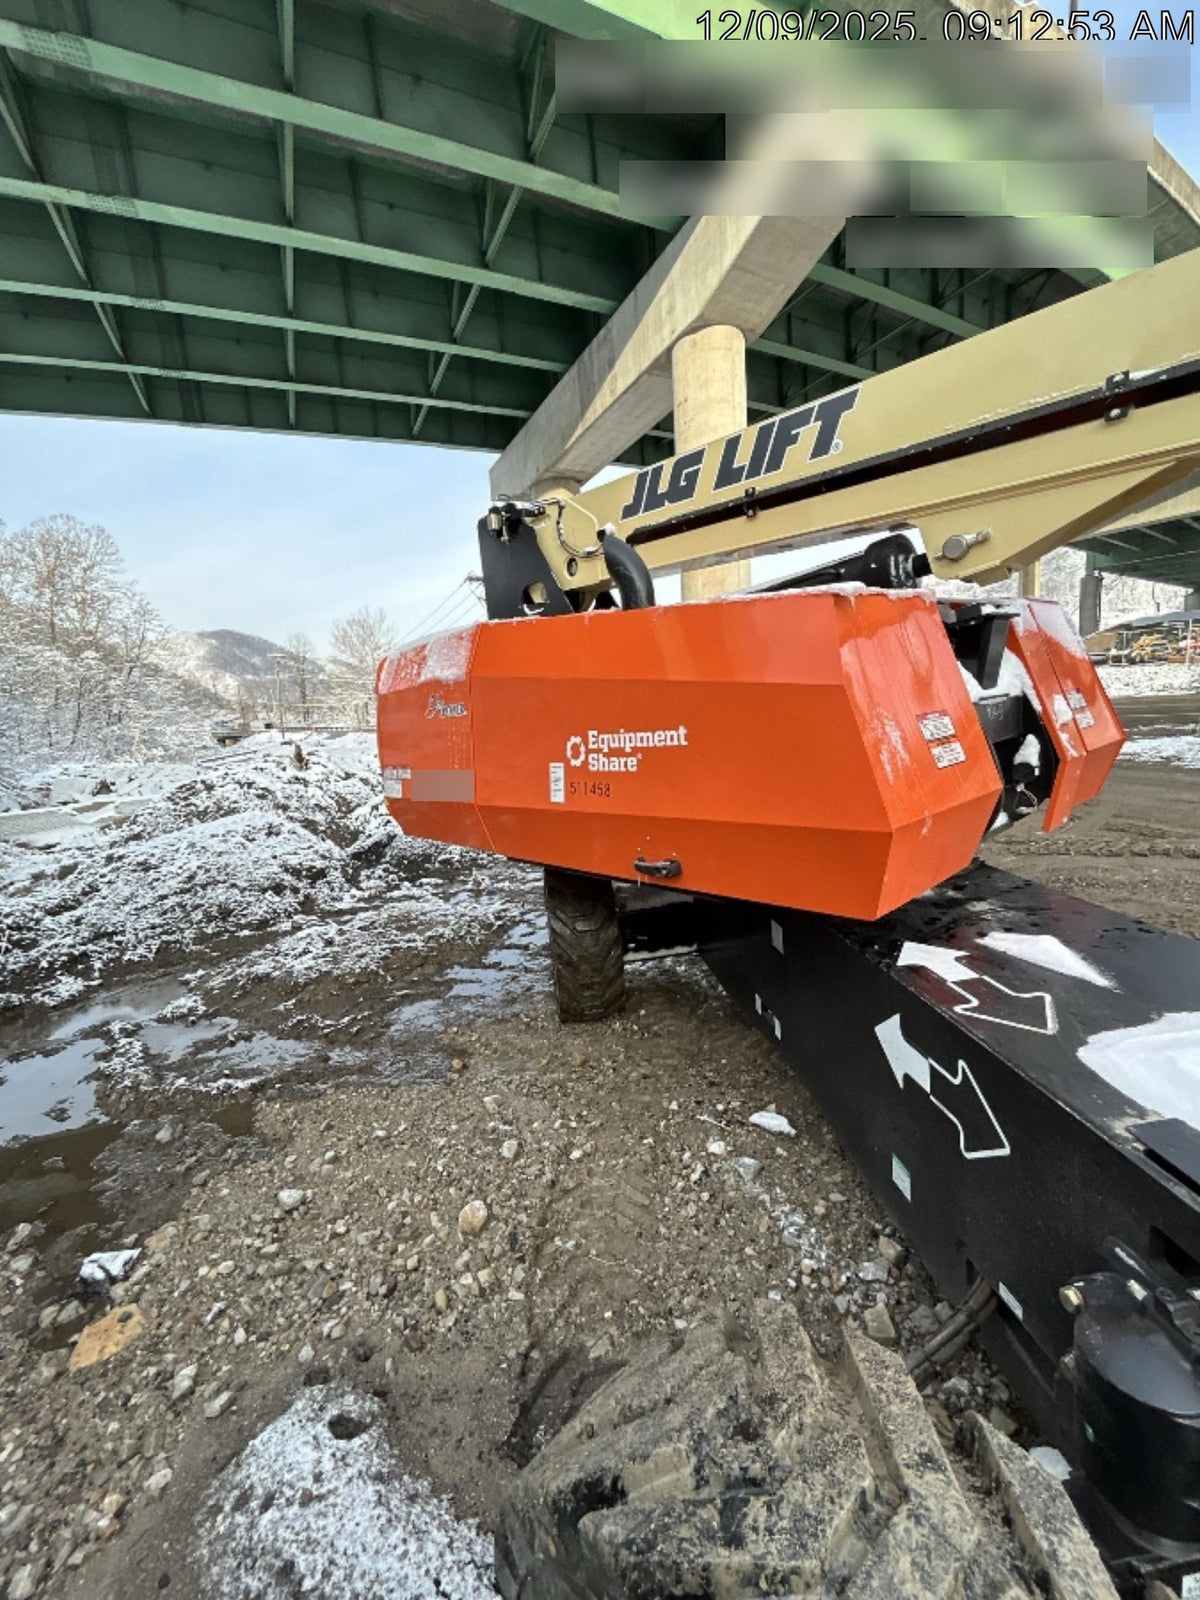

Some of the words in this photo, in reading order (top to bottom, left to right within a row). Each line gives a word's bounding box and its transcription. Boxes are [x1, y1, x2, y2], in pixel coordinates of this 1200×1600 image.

[620, 446, 707, 522] JLG
[587, 725, 688, 753] Equipment
[569, 782, 611, 798] 51458
